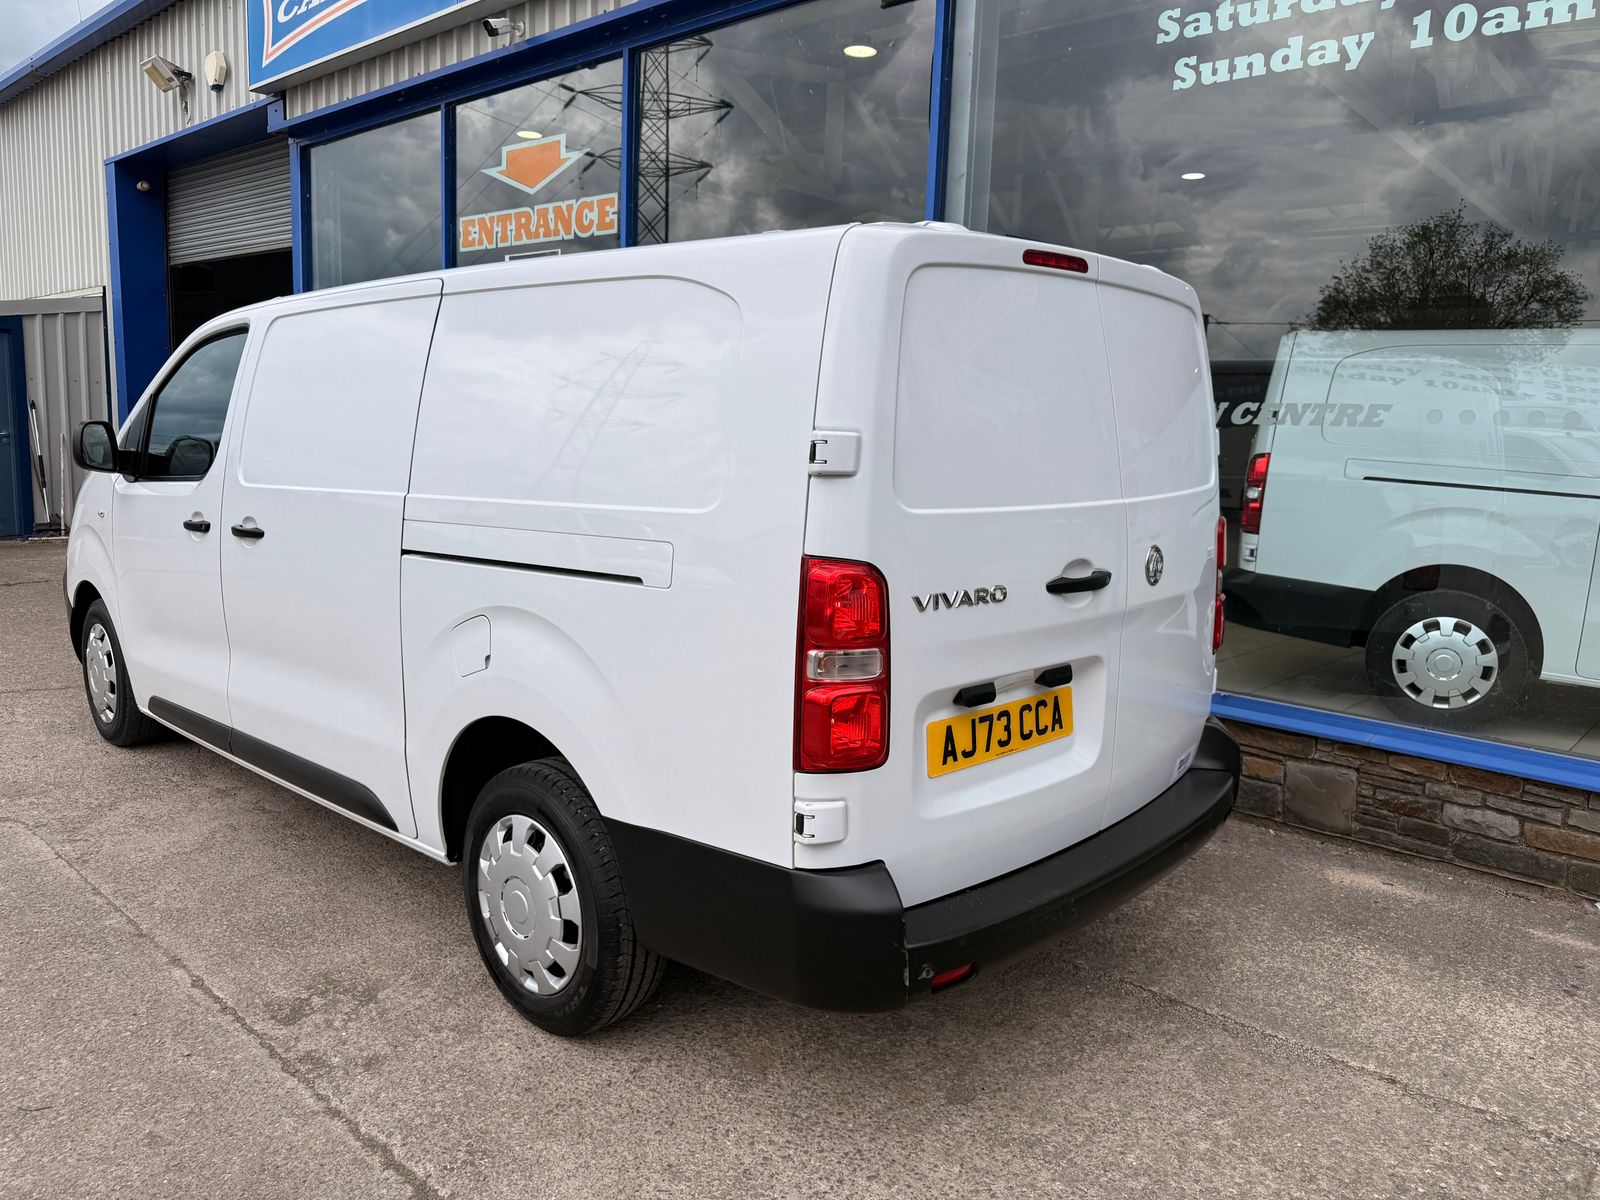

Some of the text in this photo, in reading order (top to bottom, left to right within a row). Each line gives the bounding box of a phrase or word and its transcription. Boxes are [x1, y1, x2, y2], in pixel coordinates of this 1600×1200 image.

[1173, 0, 1596, 91] Sunday 10am
[460, 194, 618, 251] ENTRANCE
[1230, 401, 1393, 428] CENTRE
[911, 584, 1008, 613] VIVARO
[942, 695, 1063, 766] AJ73 CCA
